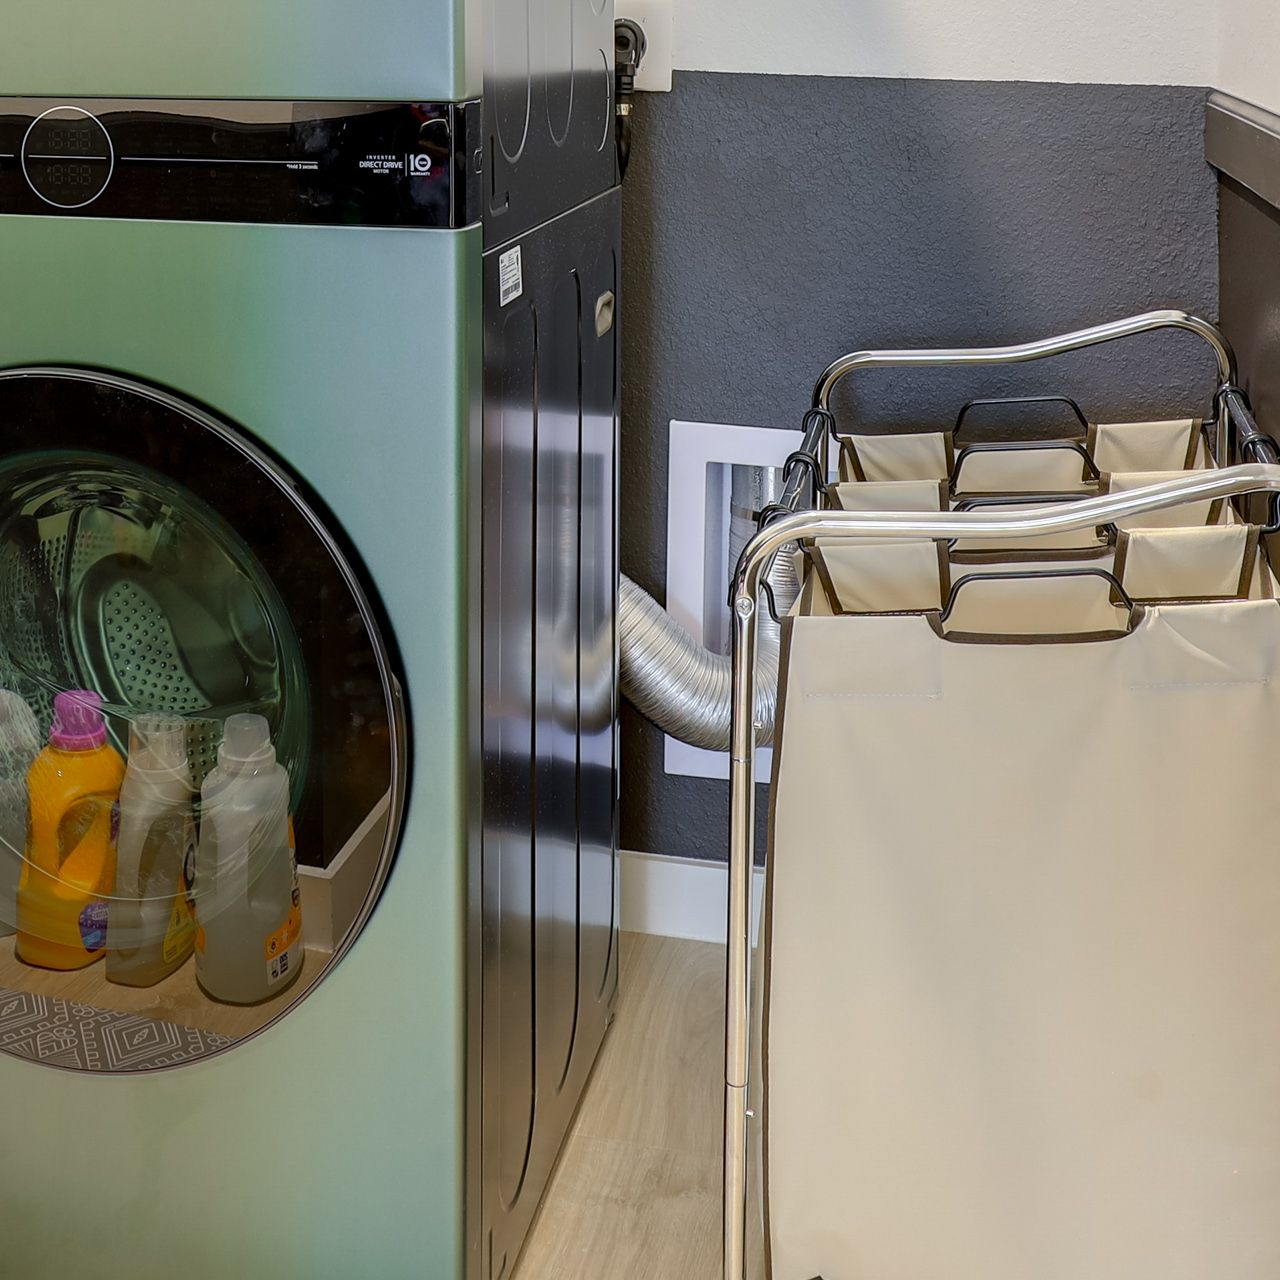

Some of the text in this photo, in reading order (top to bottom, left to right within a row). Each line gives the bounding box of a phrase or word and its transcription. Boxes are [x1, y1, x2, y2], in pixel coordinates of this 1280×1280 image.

[359, 160, 403, 169] DIRECT DRIVE
[409, 153, 432, 171] 10
